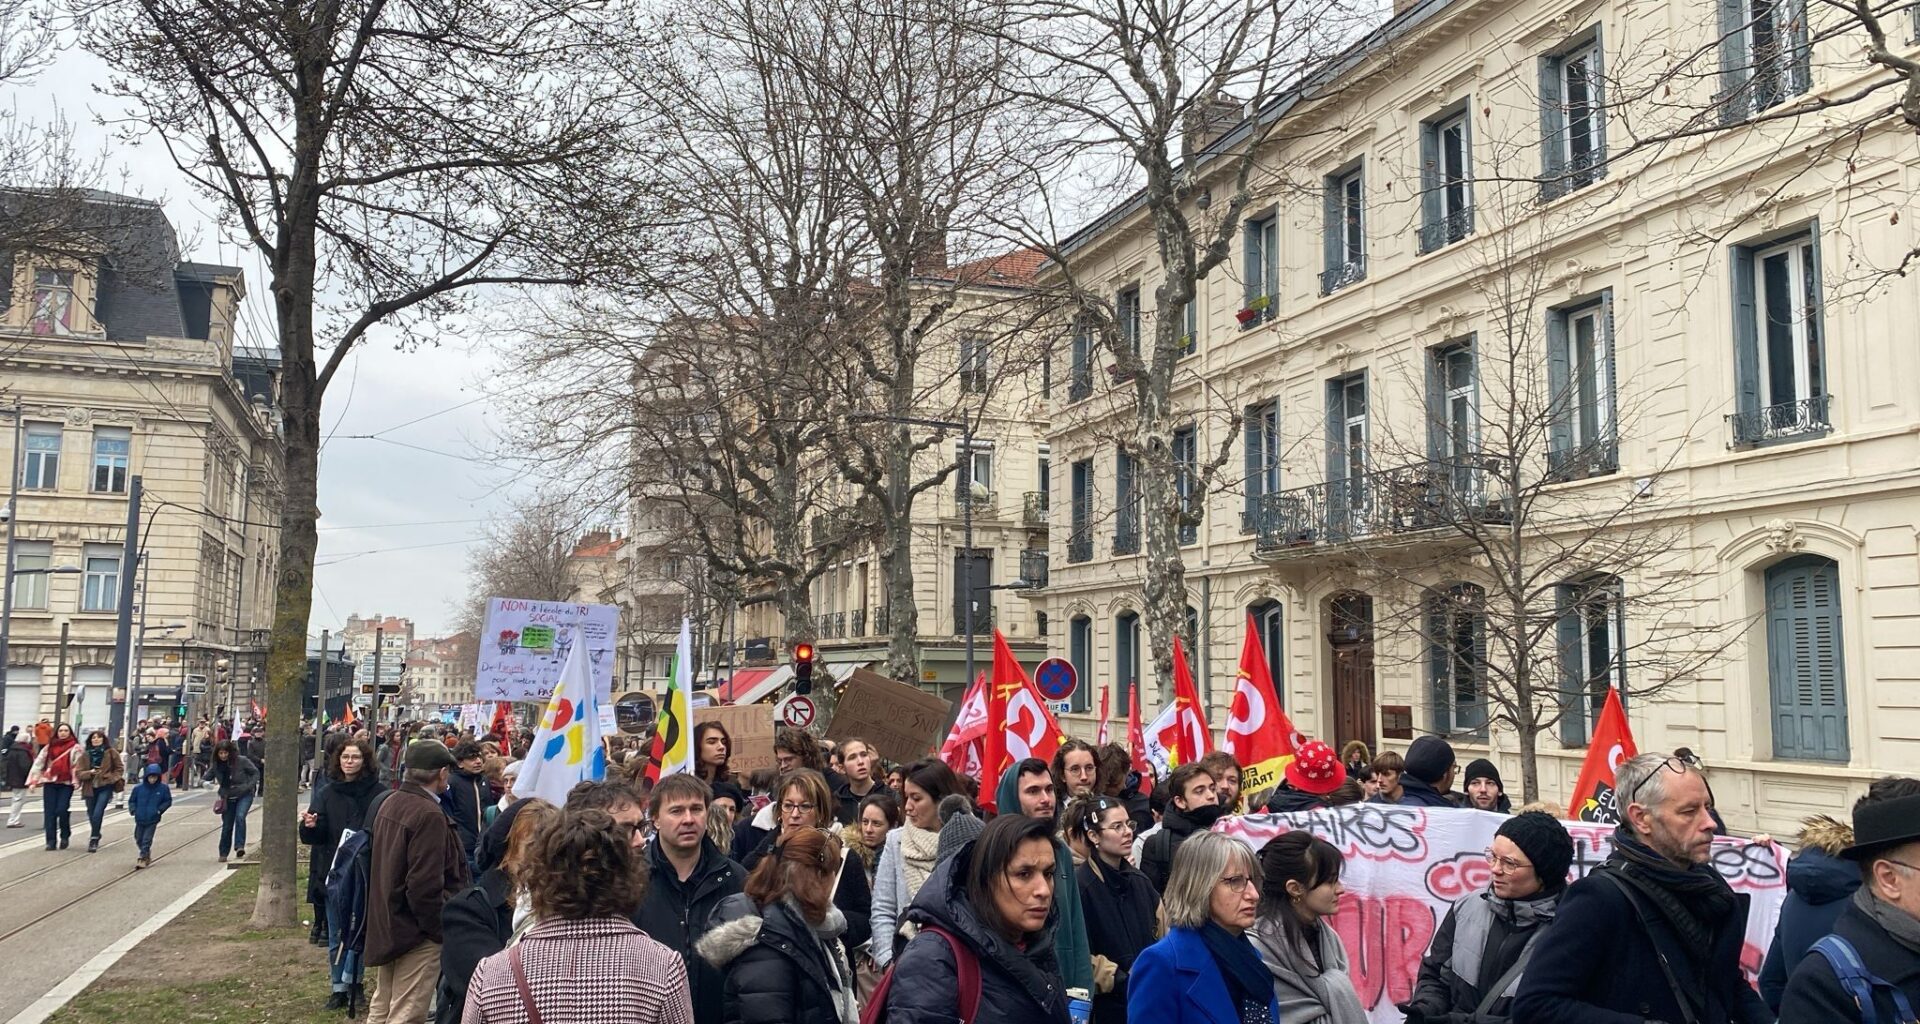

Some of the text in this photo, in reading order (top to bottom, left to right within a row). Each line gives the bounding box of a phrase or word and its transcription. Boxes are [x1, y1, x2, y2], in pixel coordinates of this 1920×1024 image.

[500, 600, 528, 612] NON
[576, 606, 589, 616] TRI
[529, 613, 559, 623] SOCIAL
[911, 710, 940, 735] SNU
[731, 756, 770, 769] STRESS
